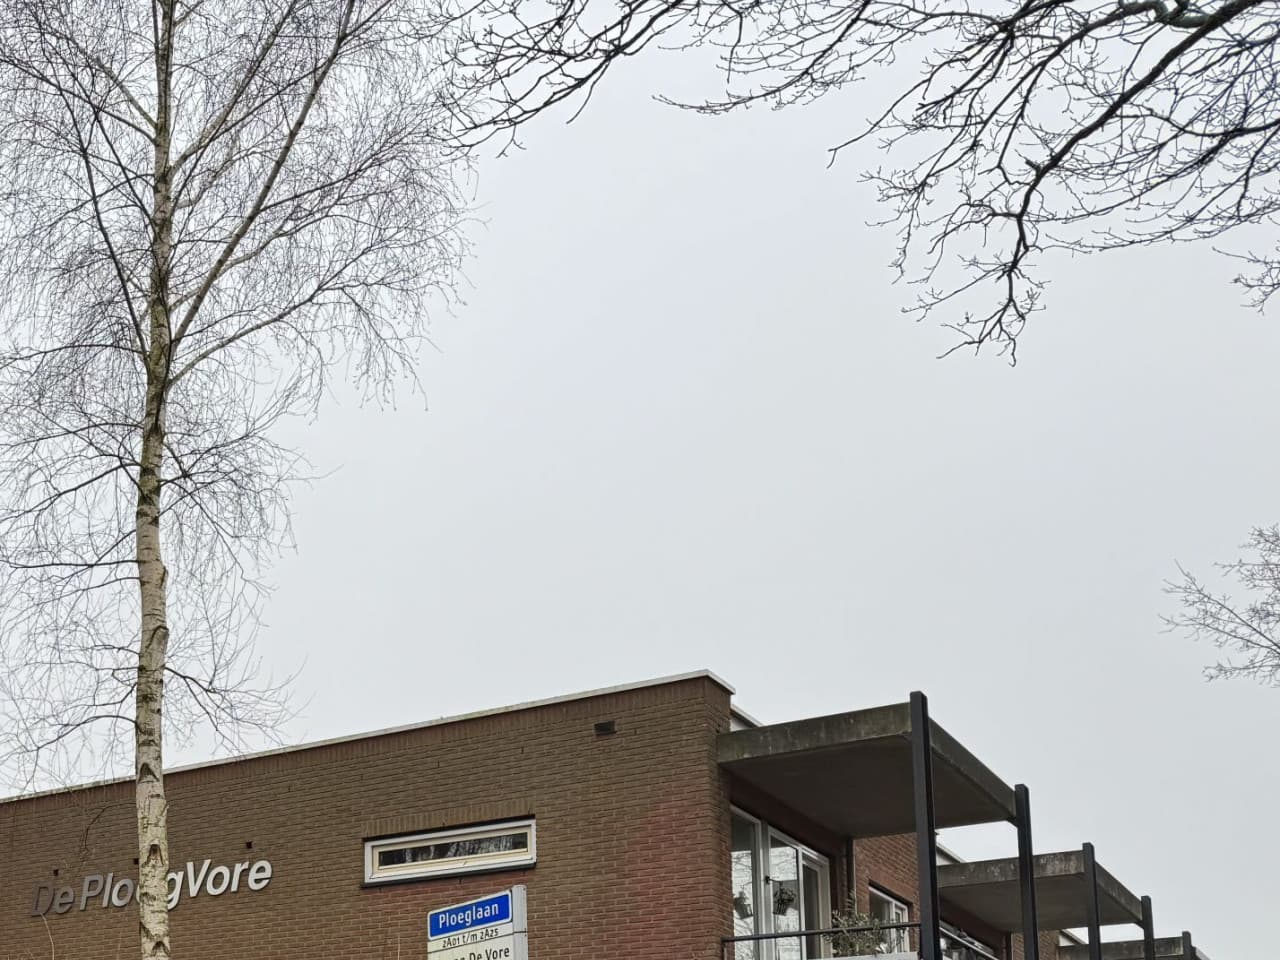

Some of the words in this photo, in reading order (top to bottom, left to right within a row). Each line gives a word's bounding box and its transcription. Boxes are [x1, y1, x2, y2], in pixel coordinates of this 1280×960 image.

[31, 882, 74, 917] De
[439, 903, 499, 929] Ploeglaan
[442, 937, 460, 949] 2A01
[462, 932, 478, 945] t/m
[480, 928, 499, 940] 2A25
[485, 947, 510, 960] Vore
